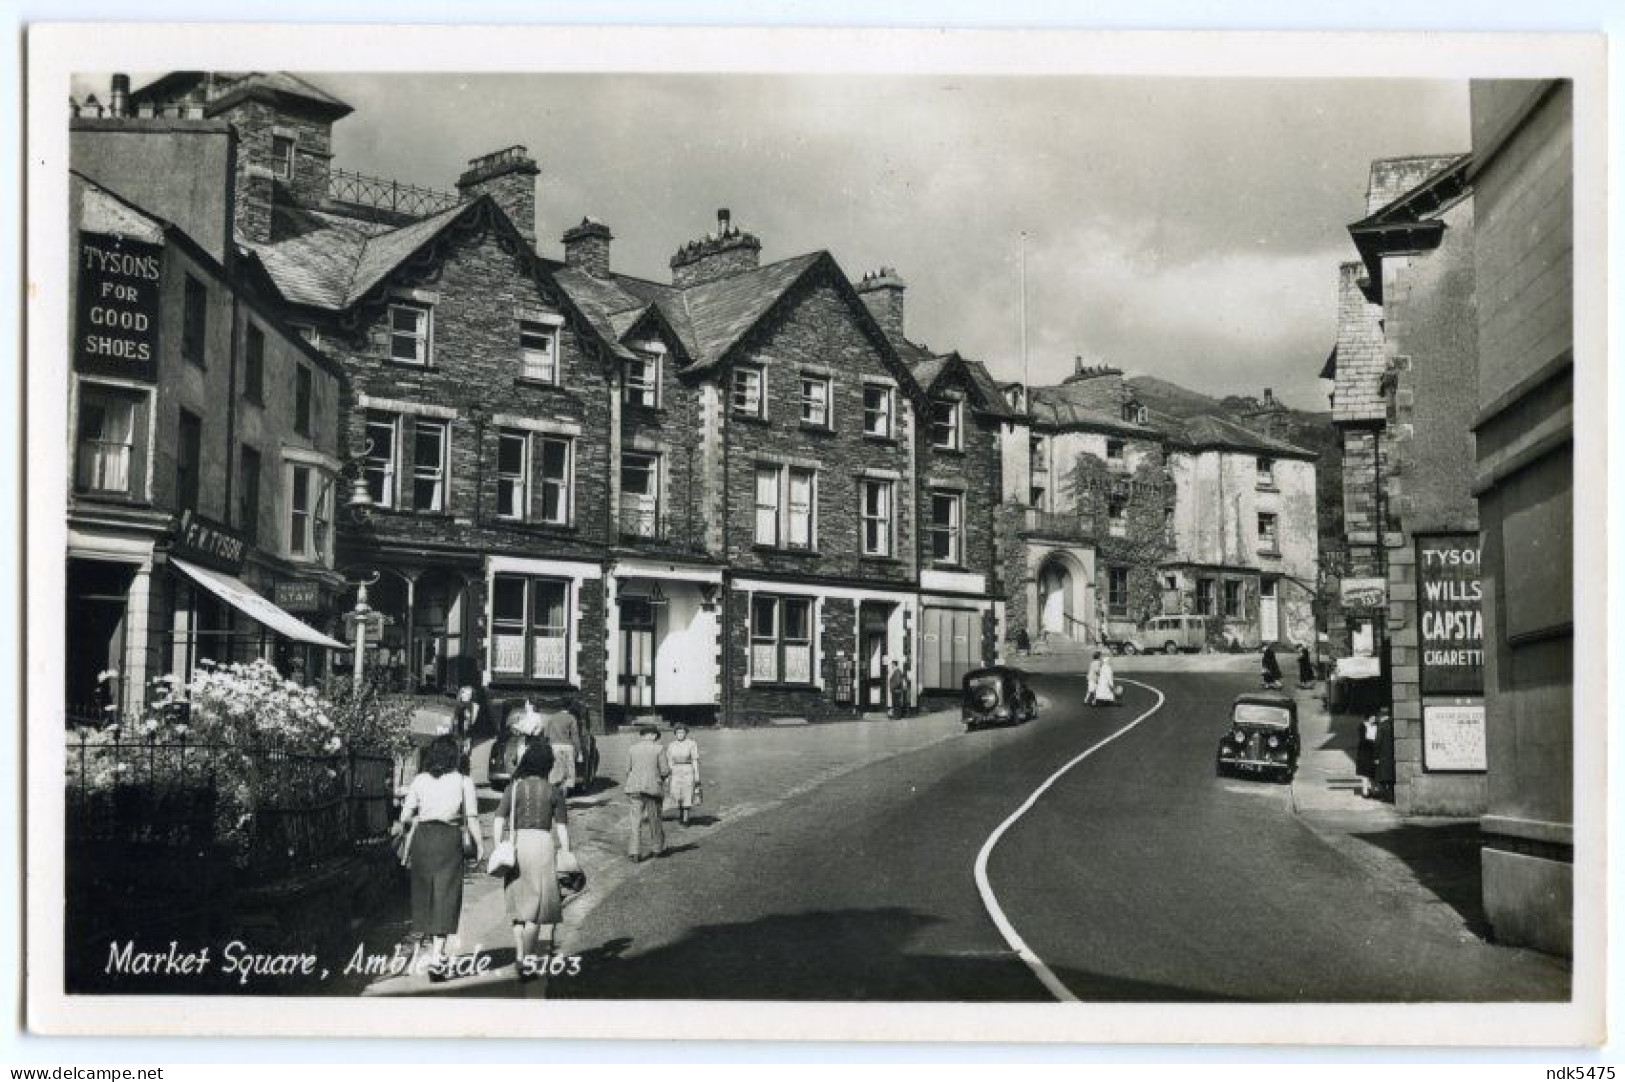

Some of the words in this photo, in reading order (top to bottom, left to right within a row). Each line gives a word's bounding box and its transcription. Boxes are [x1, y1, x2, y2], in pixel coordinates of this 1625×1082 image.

[101, 281, 139, 303] FOR
[90, 306, 149, 332] GOOD
[85, 335, 151, 360] SHOES
[1425, 580, 1483, 601] WILLS
